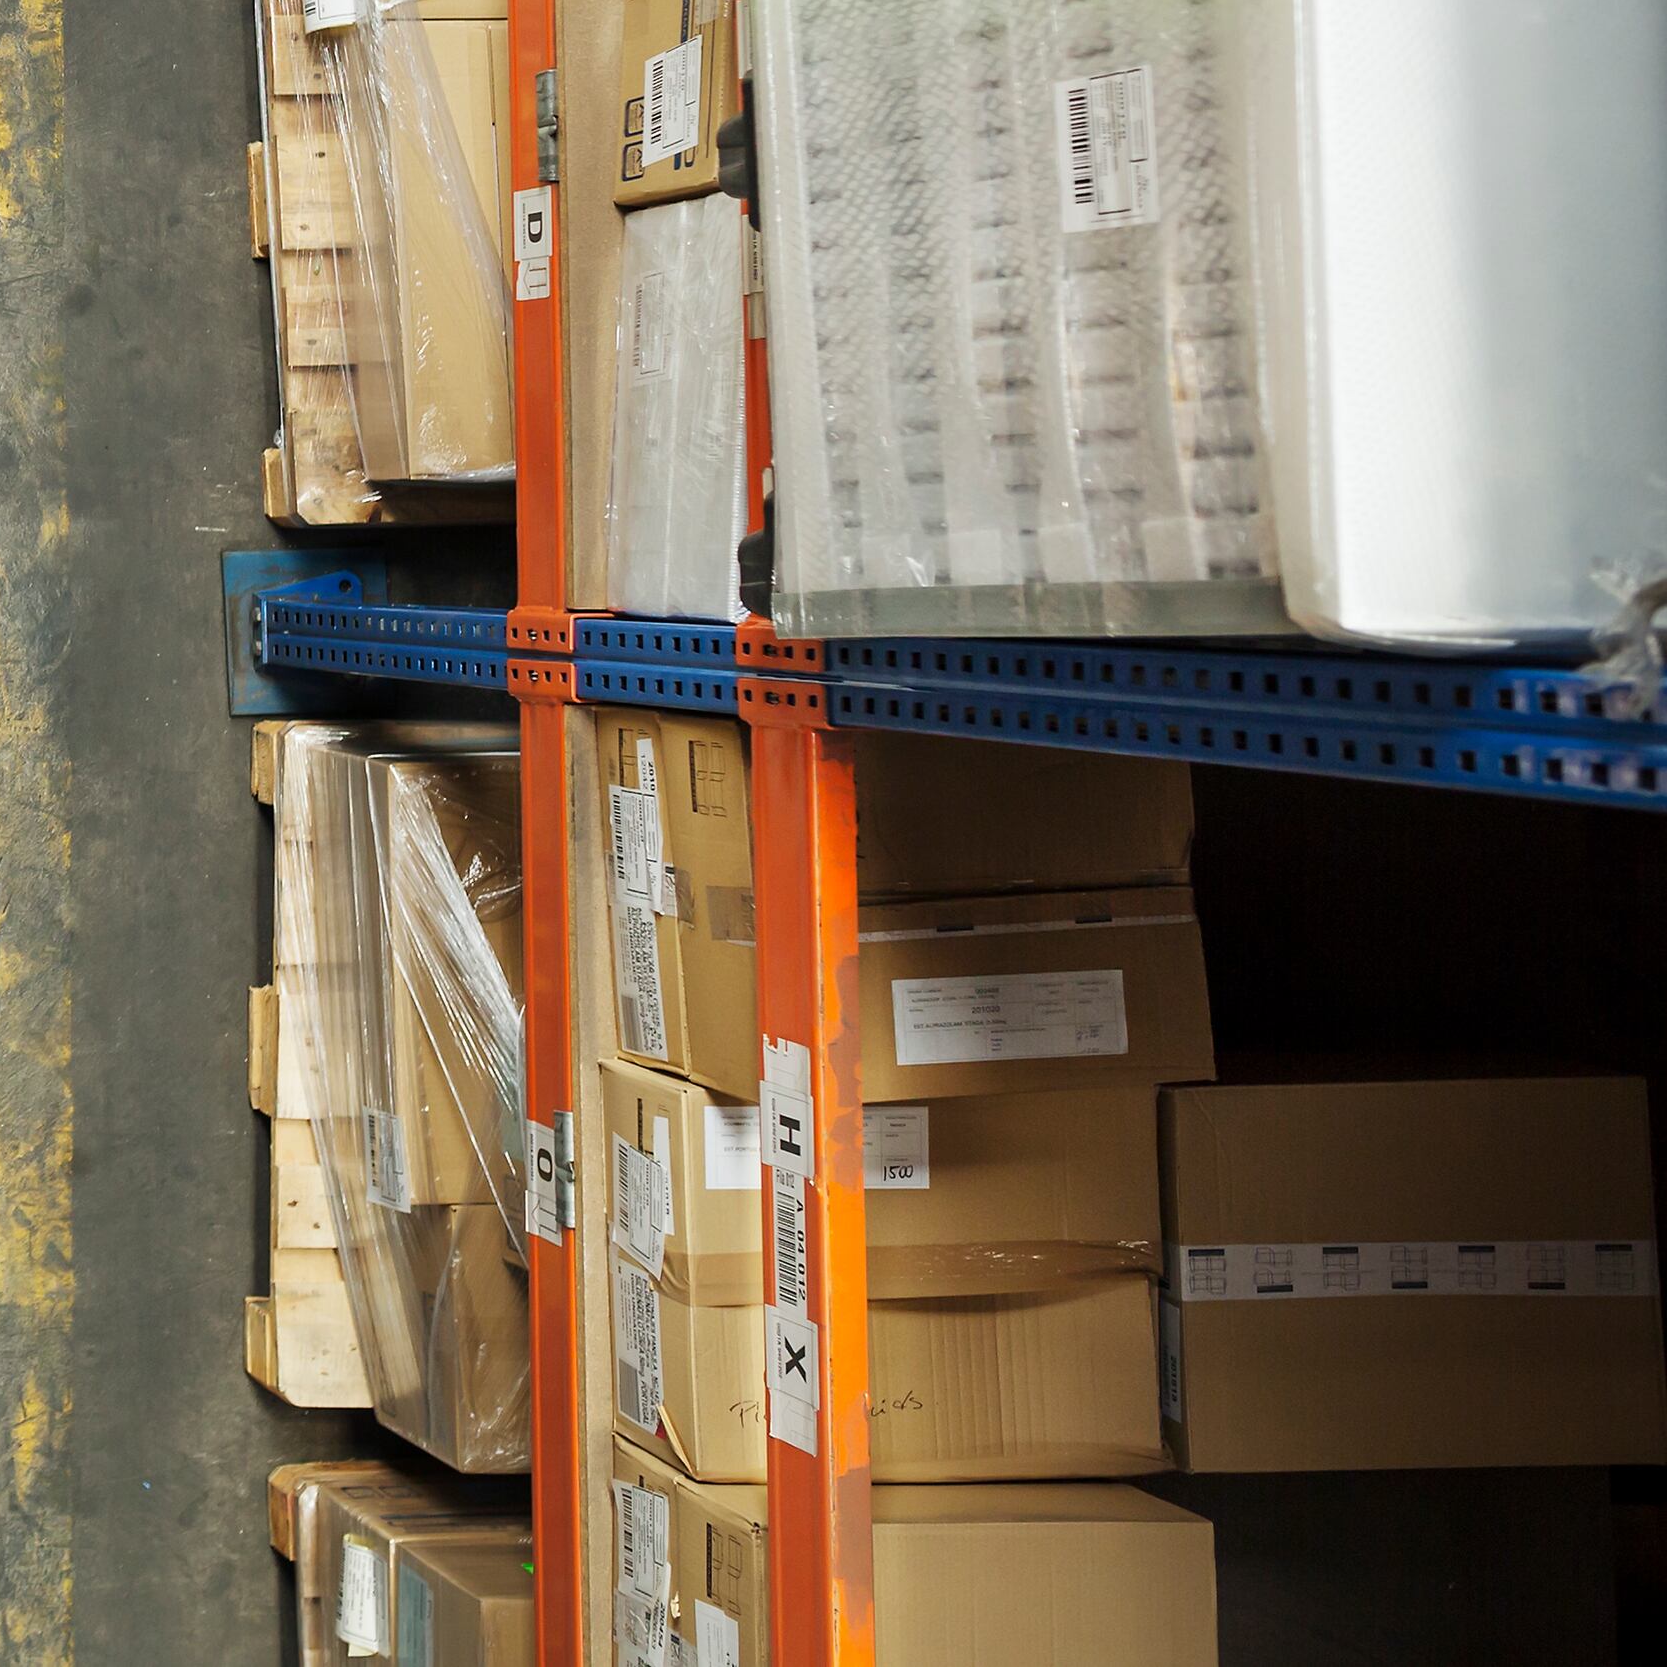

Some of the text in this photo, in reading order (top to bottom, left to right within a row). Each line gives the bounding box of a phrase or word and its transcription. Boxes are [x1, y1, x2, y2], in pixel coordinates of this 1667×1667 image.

[527, 211, 543, 244] D
[779, 1114, 802, 1157] H
[883, 1164, 914, 1183] 1500
[796, 1199, 807, 1303] A 04 012
[784, 1335, 808, 1384] X
